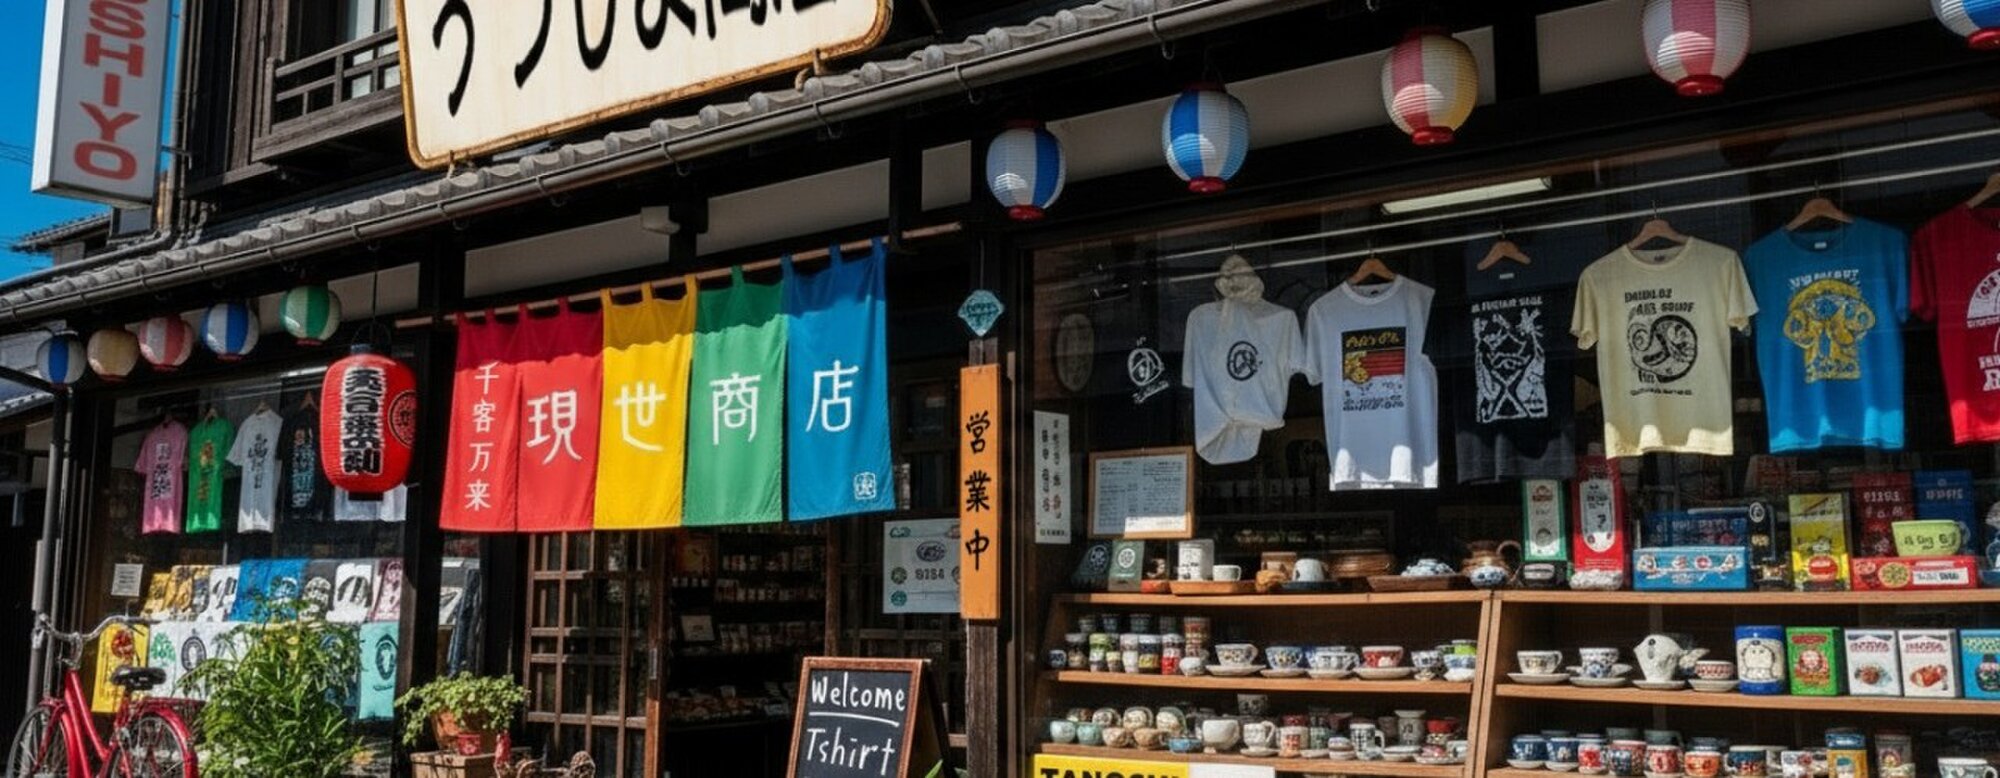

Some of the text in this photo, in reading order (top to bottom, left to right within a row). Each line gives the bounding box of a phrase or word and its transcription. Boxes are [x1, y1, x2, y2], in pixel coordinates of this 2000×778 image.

[464, 361, 500, 512] 千客万来
[525, 360, 860, 465] 現世商店
[965, 410, 992, 572] 営業中
[811, 671, 906, 711] Welcome
[806, 726, 896, 776] Tshirt
